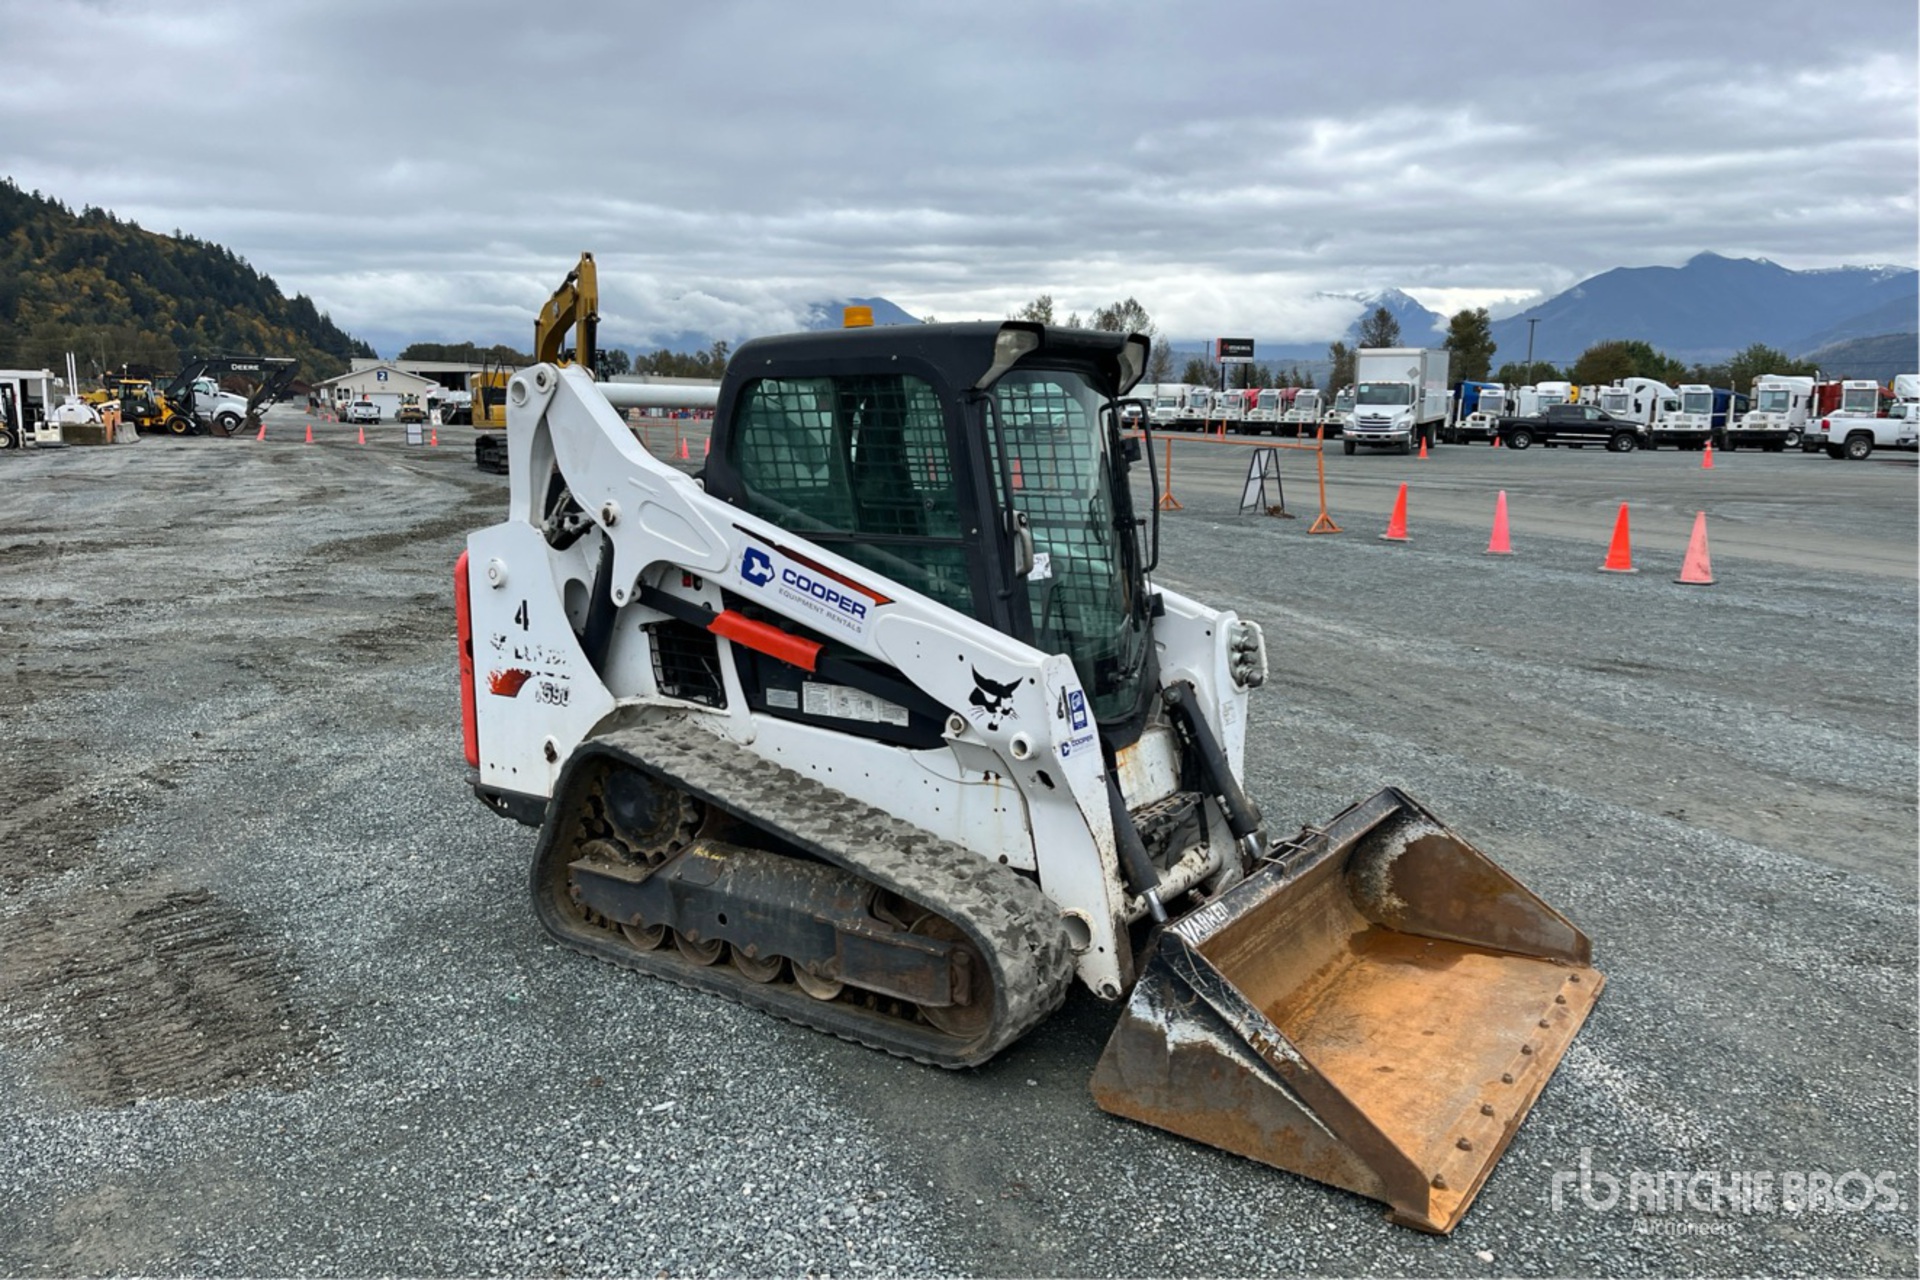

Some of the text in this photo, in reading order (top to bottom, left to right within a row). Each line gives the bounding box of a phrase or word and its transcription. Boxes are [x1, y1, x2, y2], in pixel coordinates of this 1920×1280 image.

[231, 363, 260, 371] DEERE
[379, 372, 386, 380] 2
[782, 568, 867, 620] COOPER
[514, 599, 529, 632] 4
[778, 587, 862, 634] EQUIPMENT RENTALS
[1071, 733, 1094, 747] COOPER
